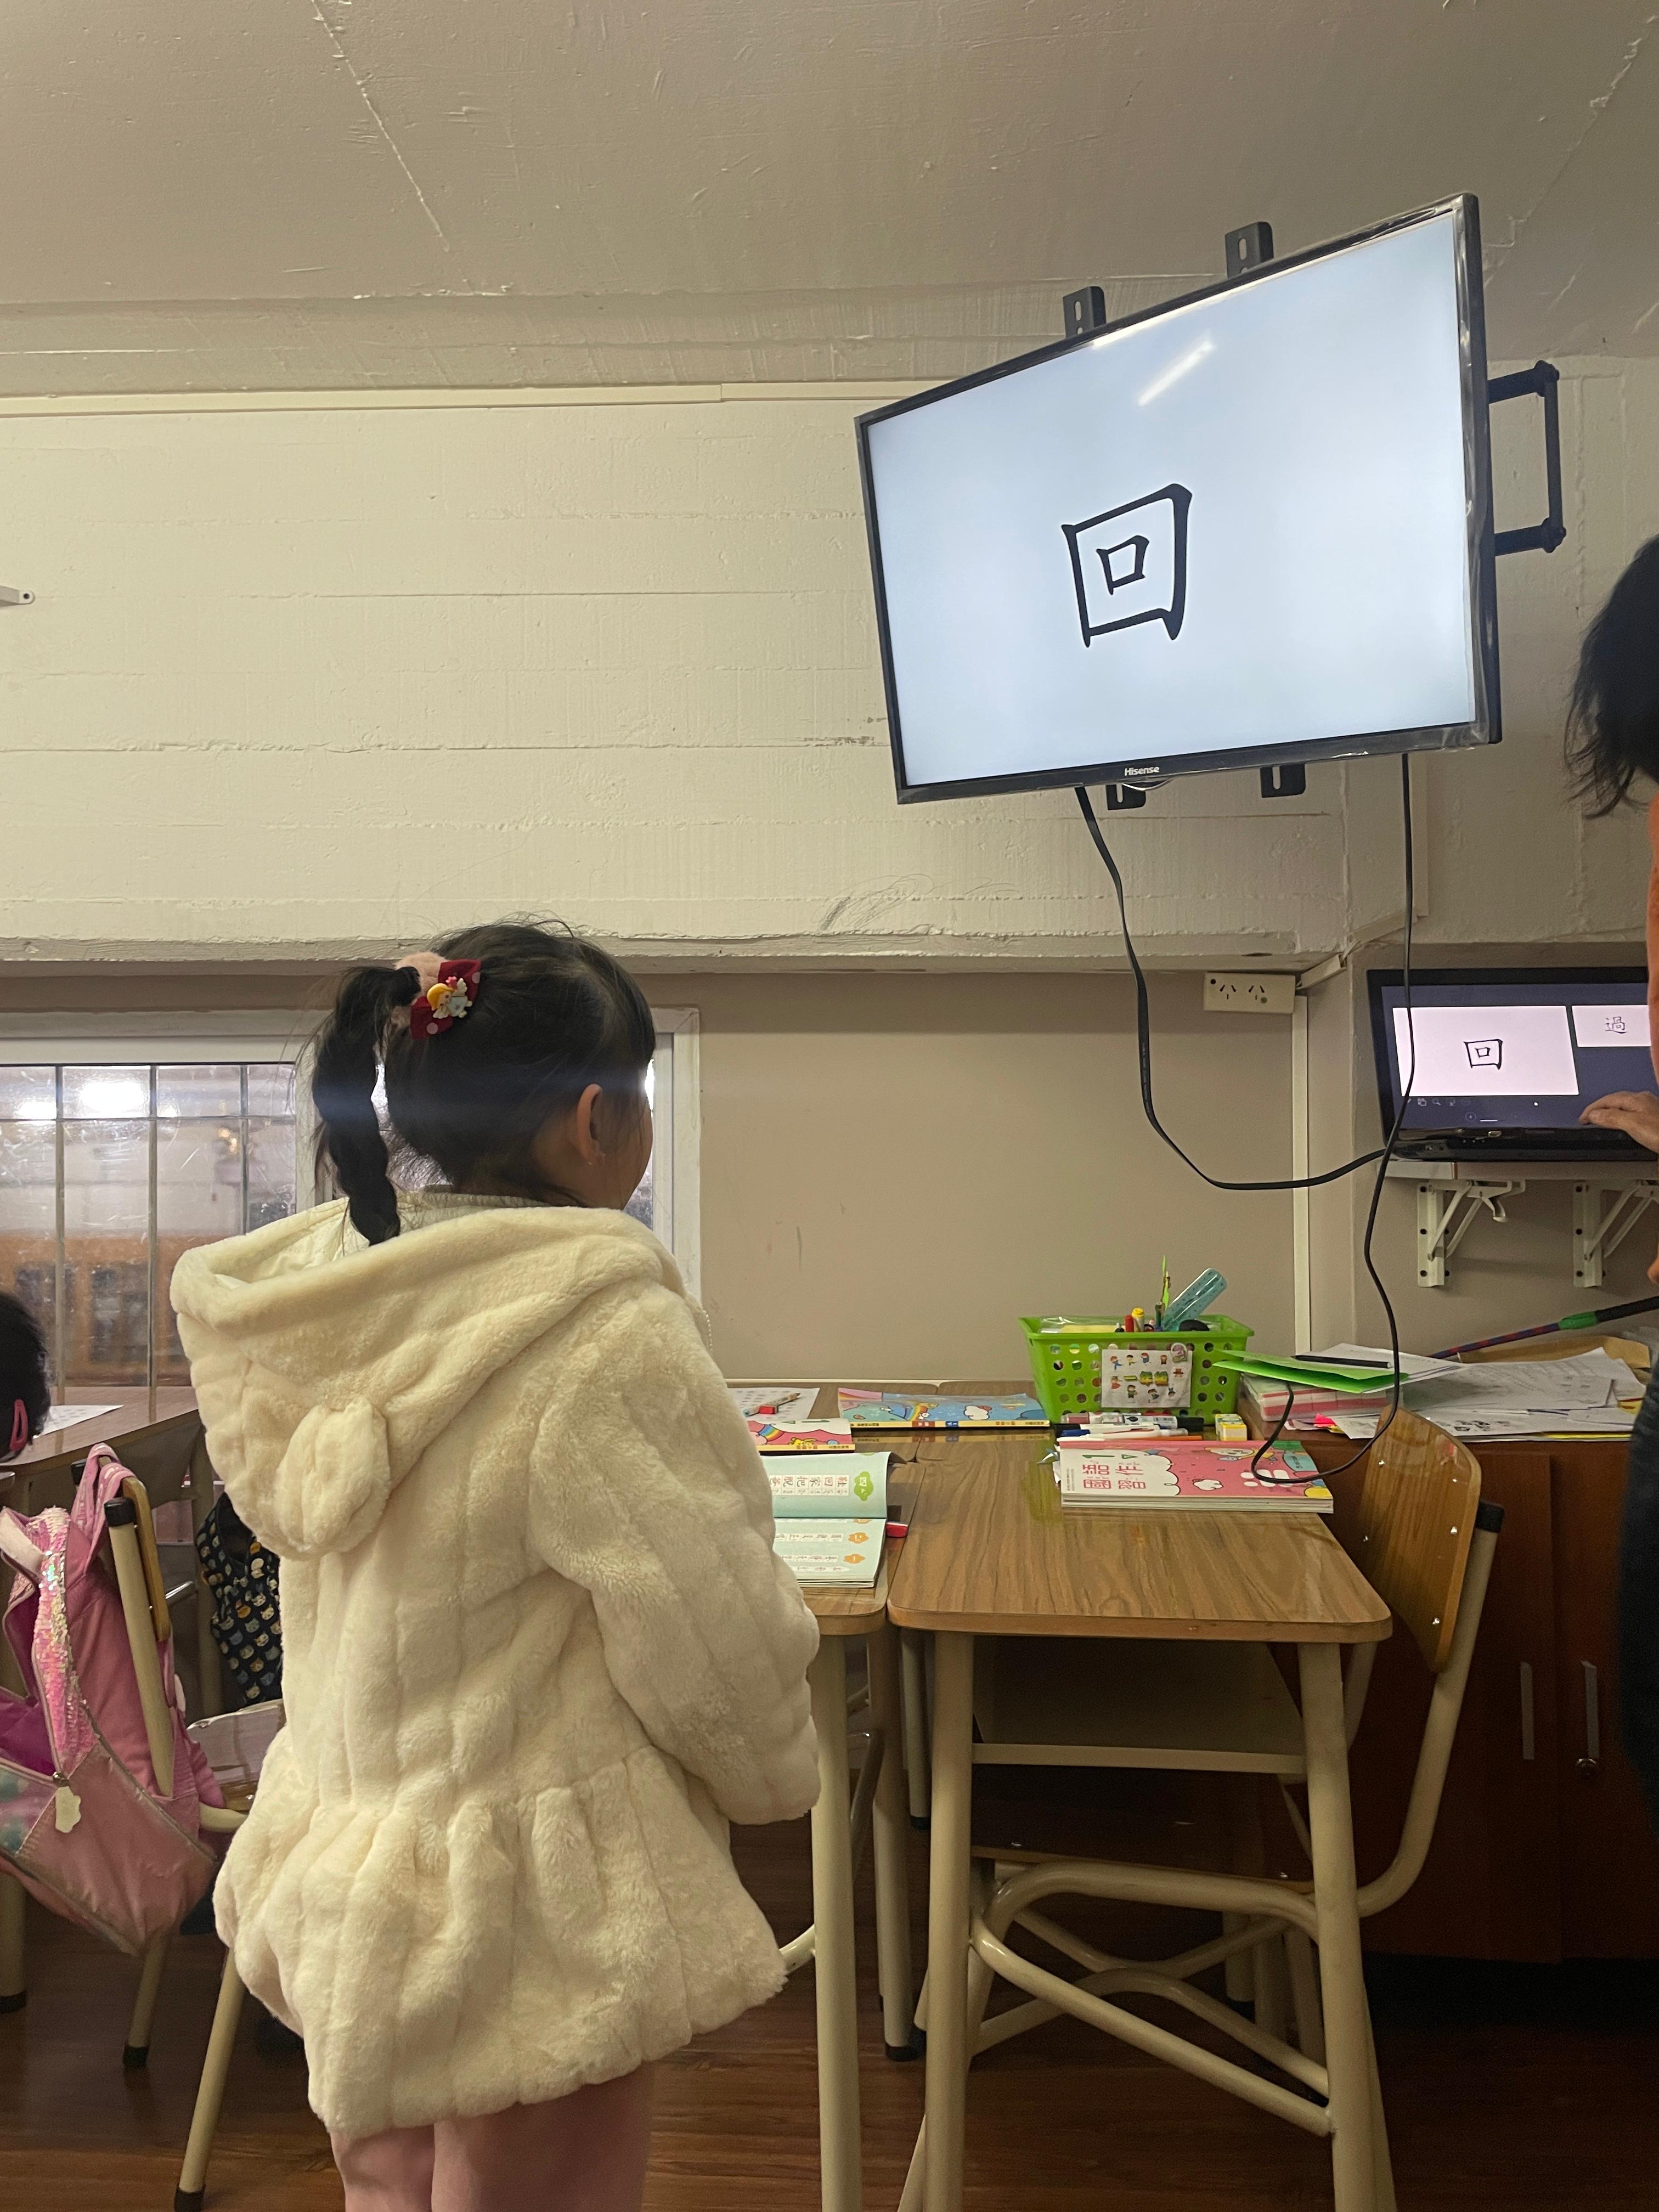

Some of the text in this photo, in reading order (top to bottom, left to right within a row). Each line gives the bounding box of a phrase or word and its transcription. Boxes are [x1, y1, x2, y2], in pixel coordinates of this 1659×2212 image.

[1061, 483, 1192, 648] 回
[1124, 766, 1160, 776] Hisense
[1605, 1016, 1628, 1034] 過
[1463, 1039, 1503, 1070] 回
[1082, 1464, 1112, 1489] 國語
[1115, 1465, 1146, 1489] 習作
